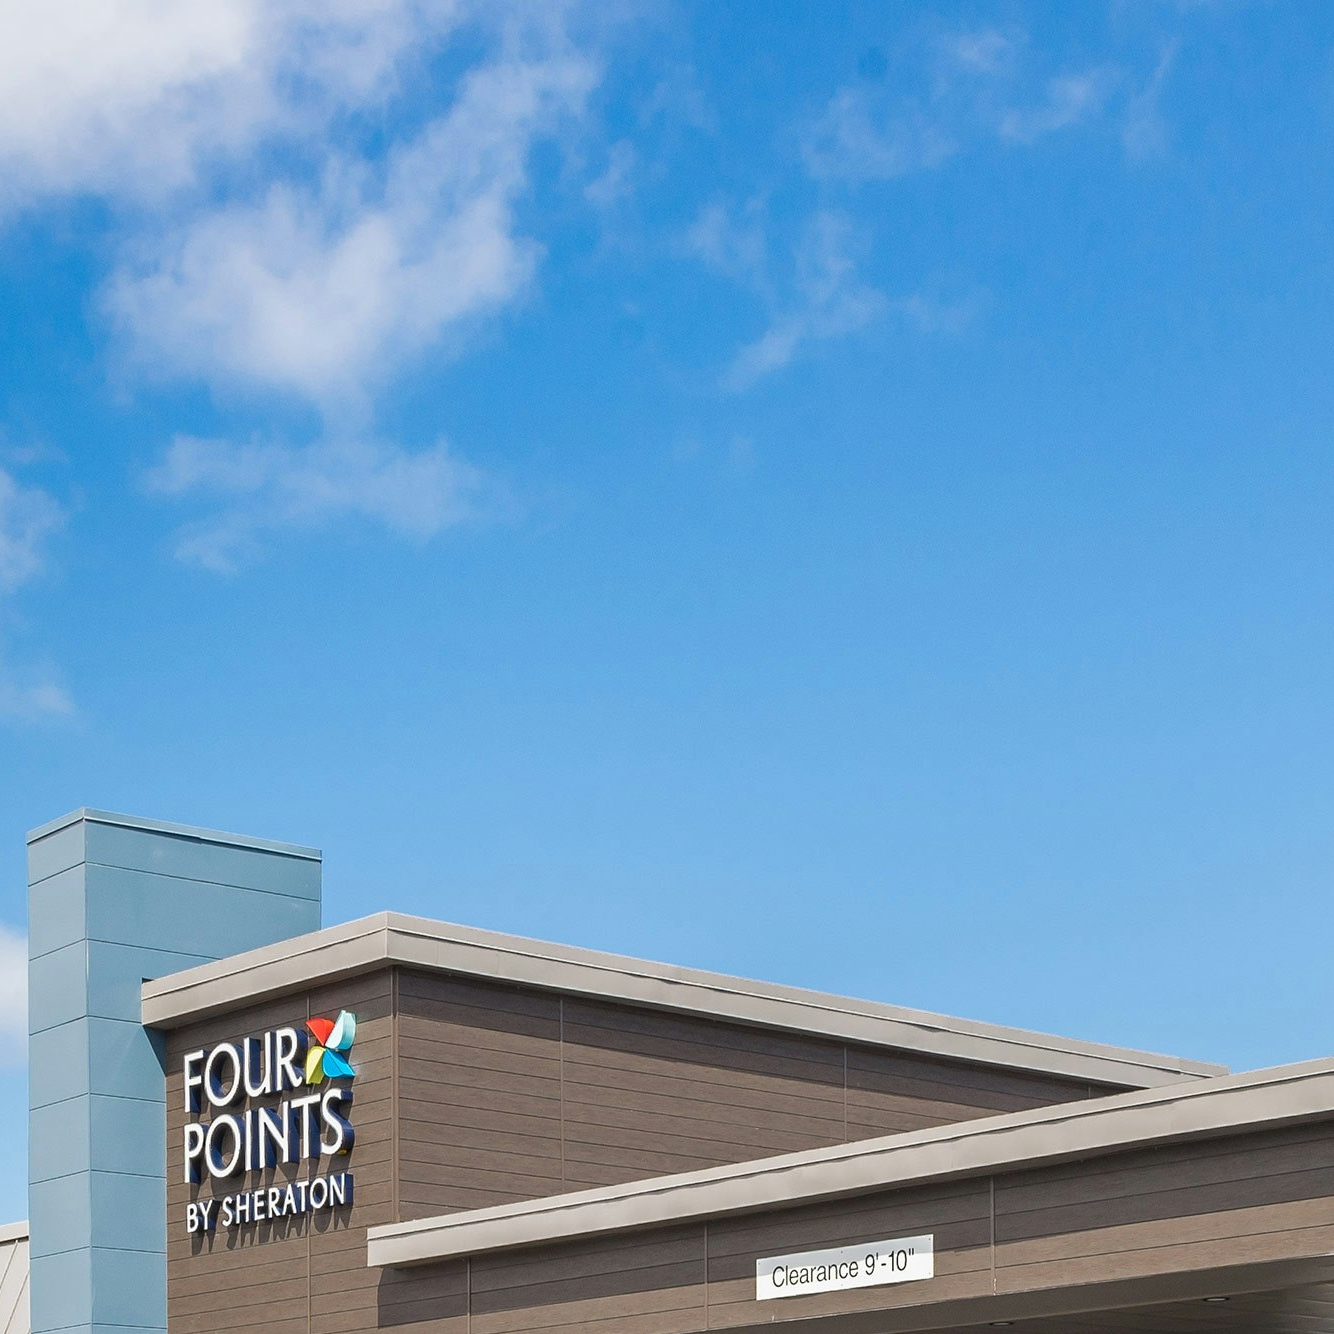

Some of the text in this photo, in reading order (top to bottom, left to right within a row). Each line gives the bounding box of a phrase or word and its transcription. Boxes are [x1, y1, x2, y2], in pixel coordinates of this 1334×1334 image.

[183, 1027, 304, 1113] FOUR
[183, 1088, 345, 1183] POINTS
[186, 1172, 345, 1233] BY SHERATON
[772, 1248, 915, 1288] Clearance 9'-10"
